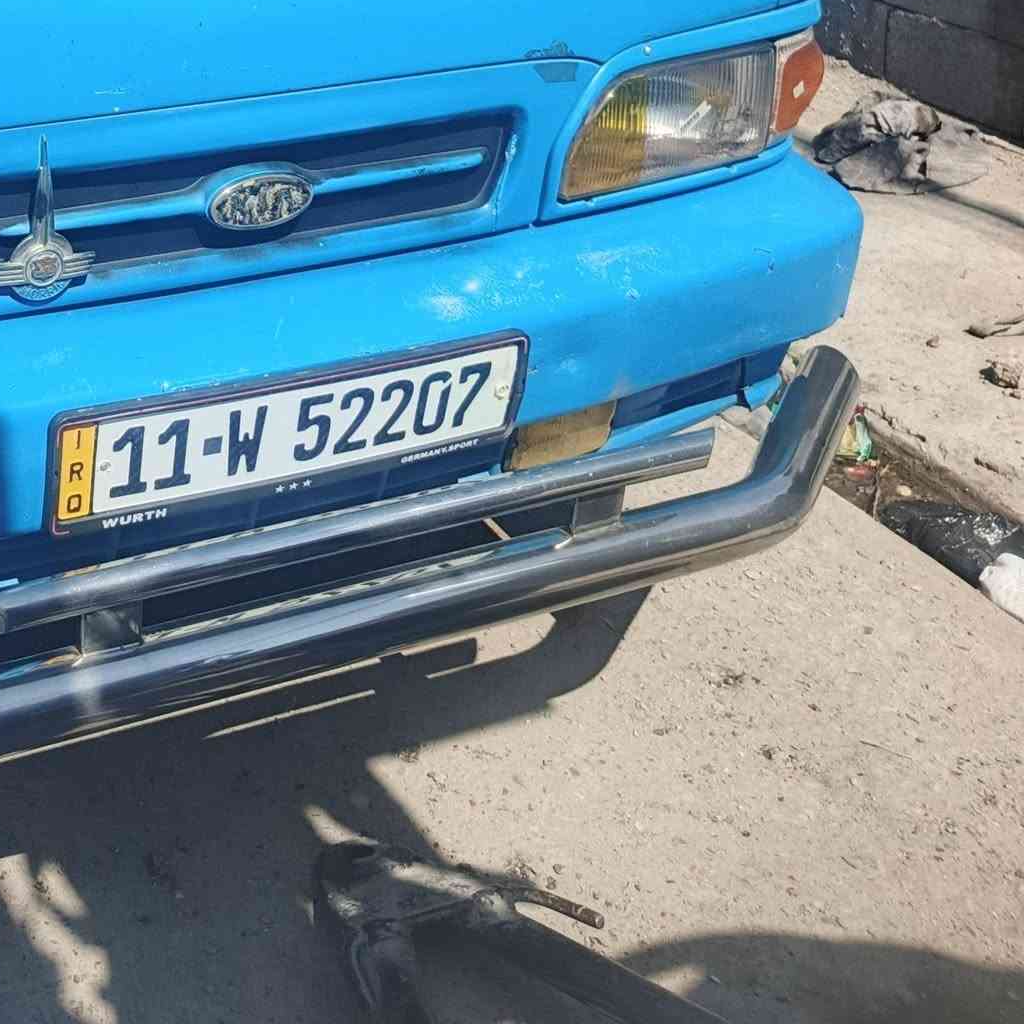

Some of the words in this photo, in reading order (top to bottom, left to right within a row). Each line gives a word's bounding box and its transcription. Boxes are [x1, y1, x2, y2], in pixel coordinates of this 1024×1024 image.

[293, 361, 492, 461] 52207
[66, 429, 84, 514] IRQ
[102, 508, 168, 529] WURTH
